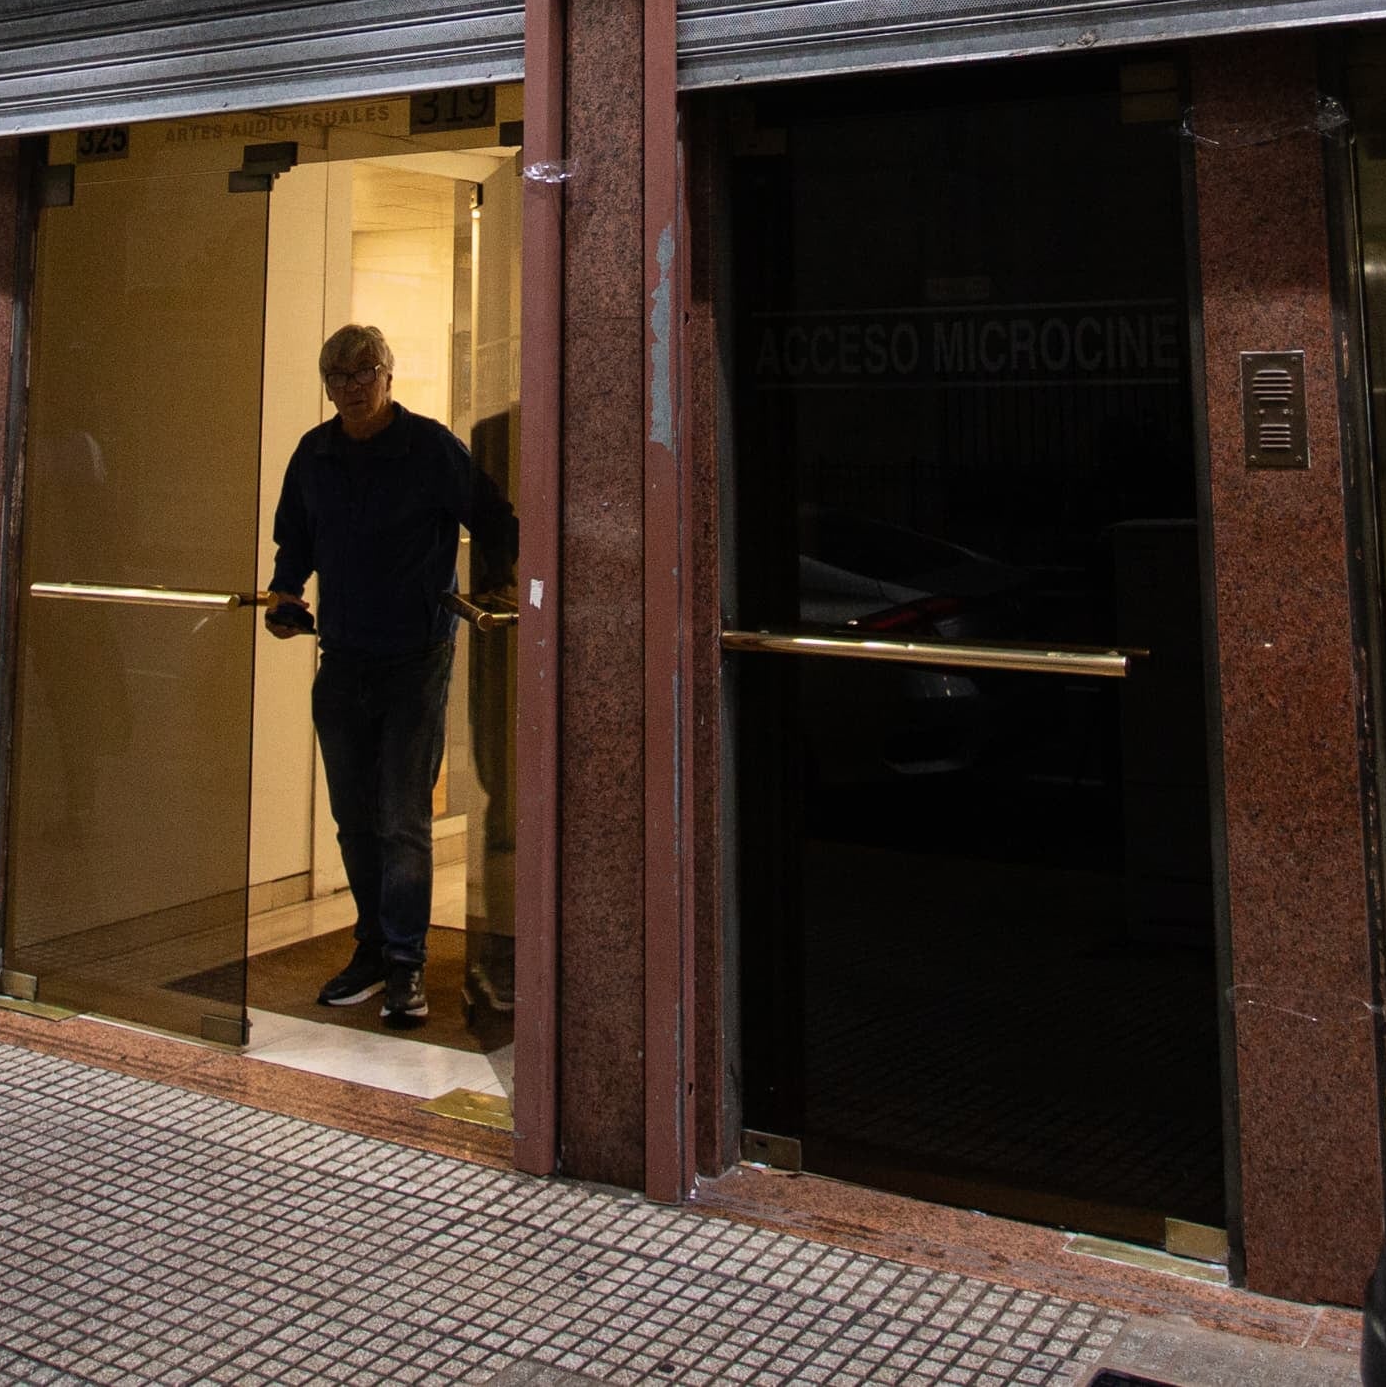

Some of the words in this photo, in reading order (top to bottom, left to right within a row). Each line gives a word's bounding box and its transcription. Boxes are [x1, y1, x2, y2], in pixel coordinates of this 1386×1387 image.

[164, 121, 223, 144] ARTES
[230, 103, 391, 140] AUDIOVISUALES
[417, 86, 490, 125] 319
[79, 126, 128, 156] 325
[755, 321, 920, 375] ACCESO
[933, 315, 1181, 374] MICROCINE
